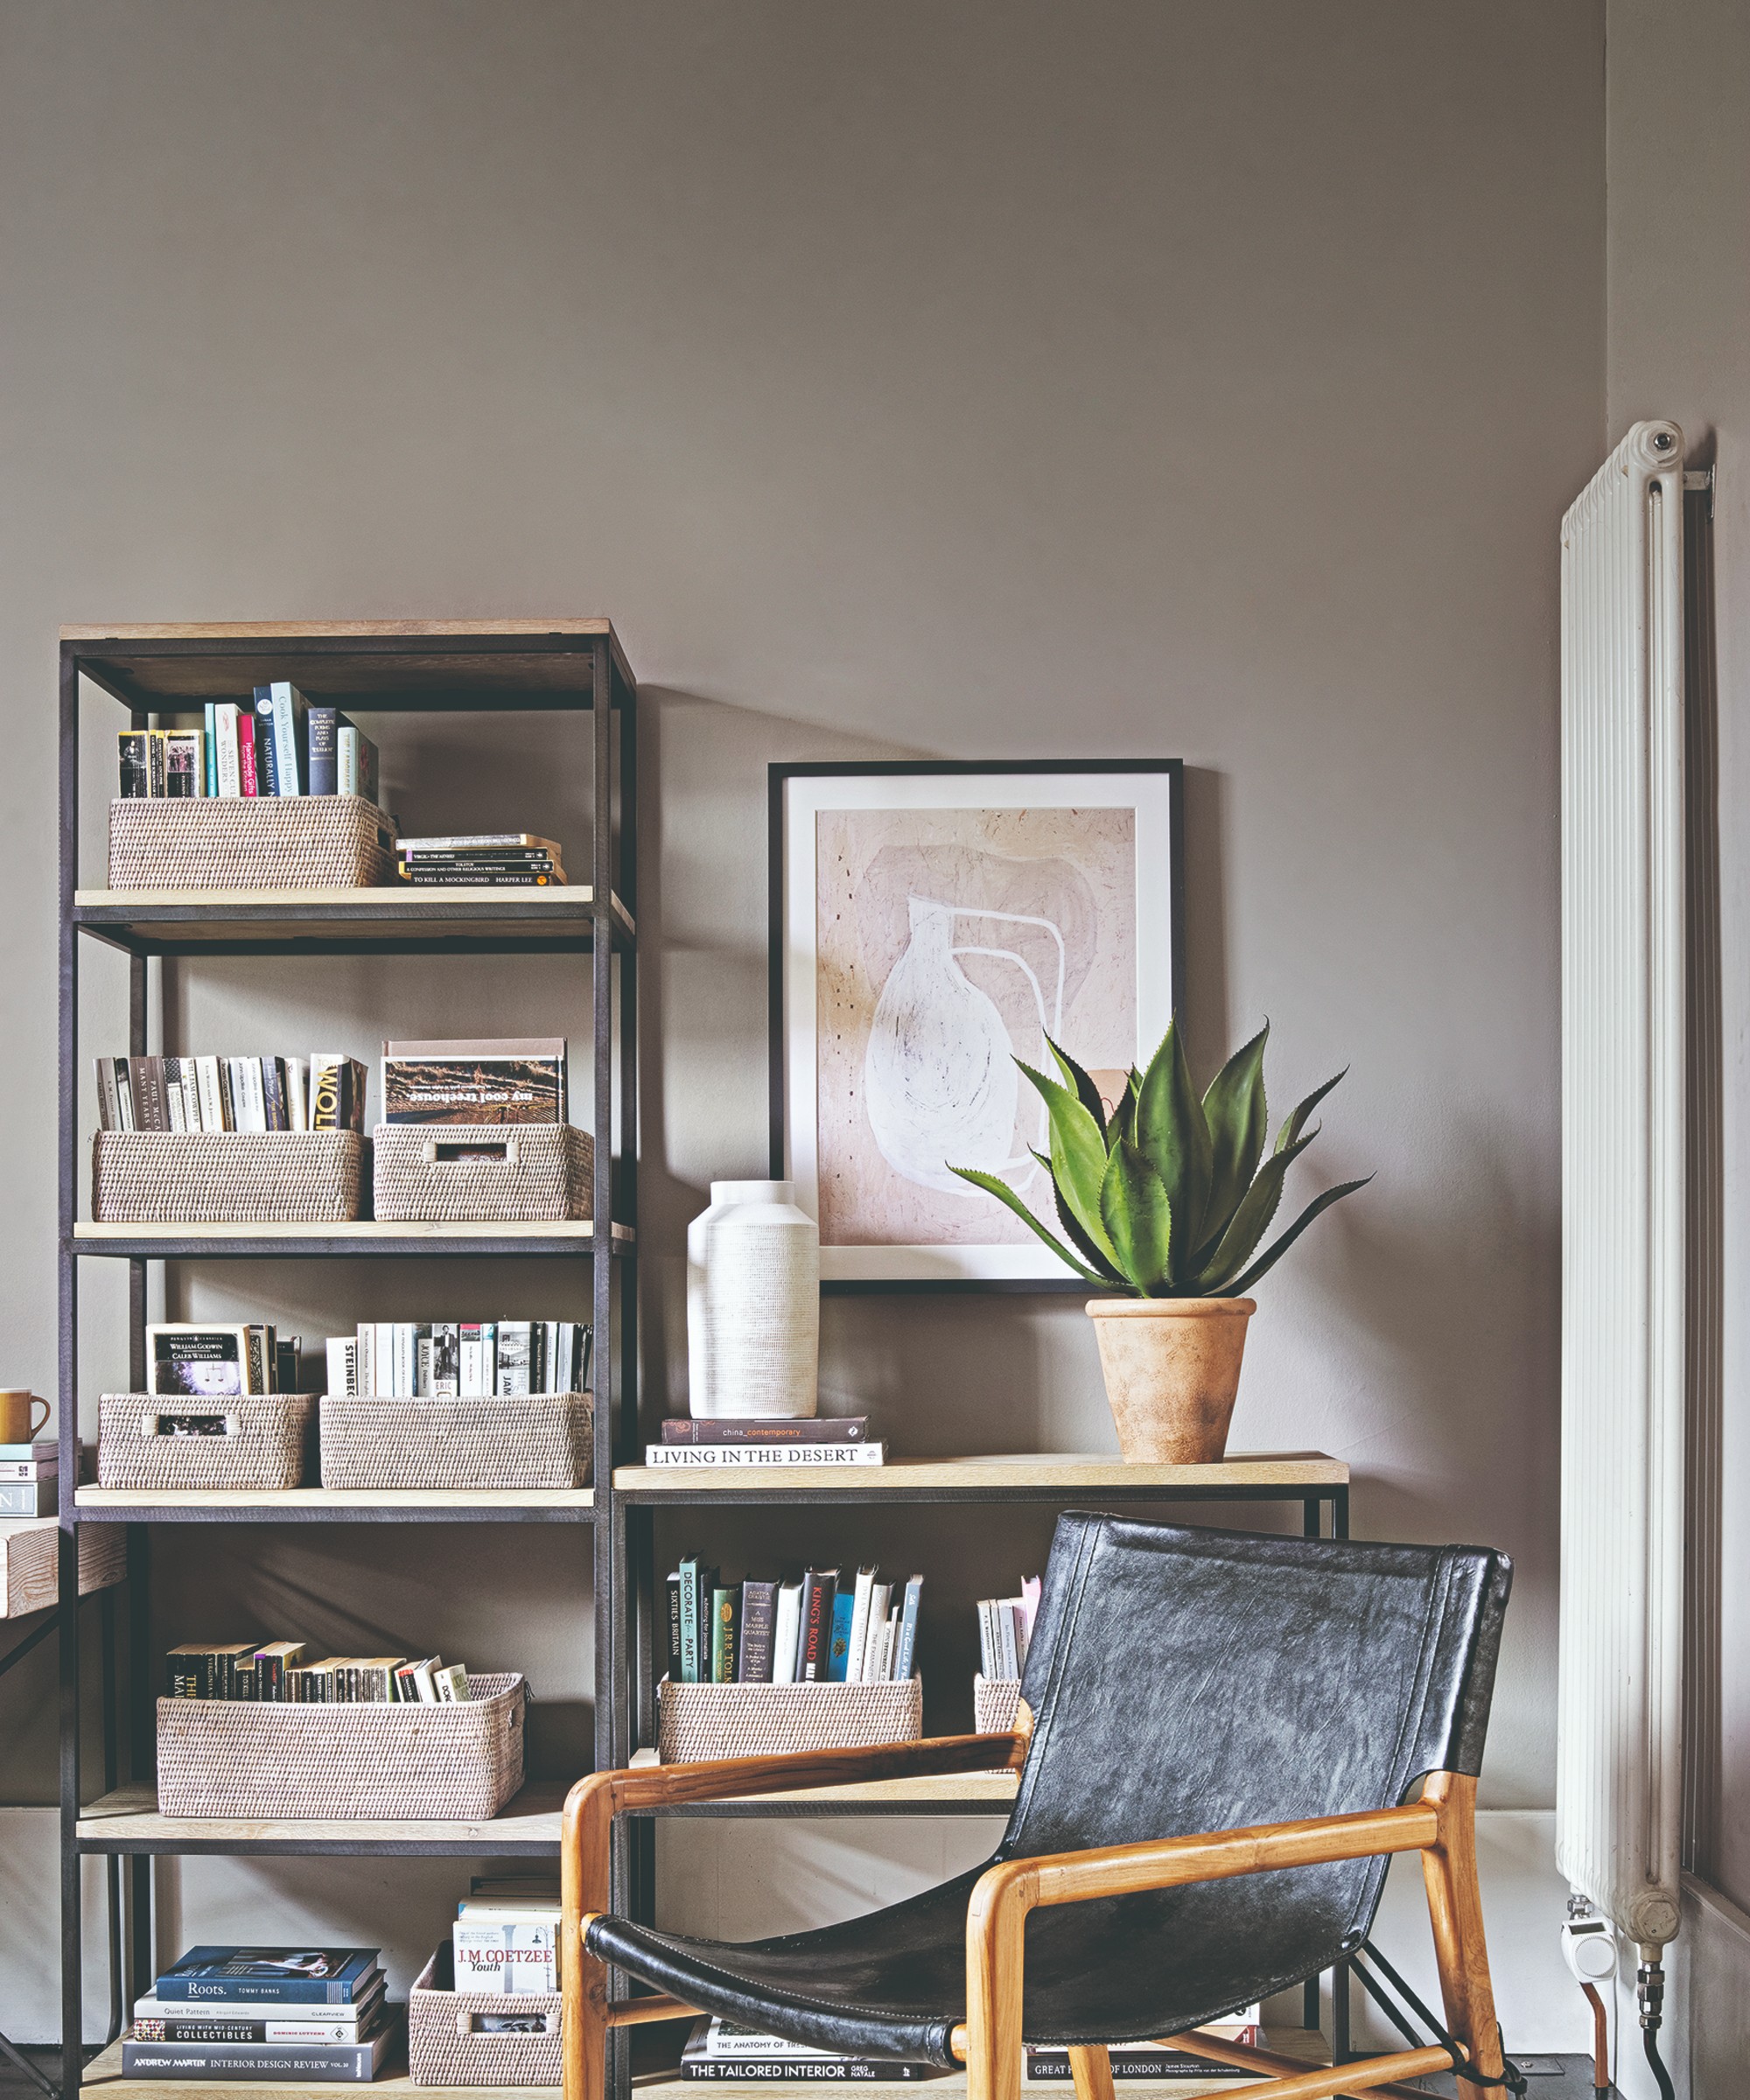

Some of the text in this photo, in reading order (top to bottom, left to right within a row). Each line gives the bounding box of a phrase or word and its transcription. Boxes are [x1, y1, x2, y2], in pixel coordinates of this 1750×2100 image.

[278, 696, 294, 794] Cook Yourself Happy
[220, 739, 229, 783] WONDERS
[245, 742, 257, 794] Handmade Gifts
[263, 738, 276, 789] NATURALLY
[187, 1059, 196, 1092] WILLIAM
[139, 1067, 151, 1124] MANY YEARS
[150, 1081, 158, 1102] PAUL
[479, 1092, 508, 1102] cool
[512, 1091, 533, 1102] my
[191, 1093, 200, 1124] COWPER
[421, 1344, 430, 1368] JOYCE
[652, 1448, 858, 1464] LIVING IN THE DESERT
[684, 1572, 693, 1624] DECORATE
[809, 1586, 822, 1625] KING'S
[670, 1590, 680, 1656] SIXTIES BRITAIN
[857, 1618, 865, 1652] THOMAS
[685, 1638, 694, 1669] PARTY
[807, 1628, 818, 1660] ROAD
[881, 1642, 891, 1673] STEINBECK
[903, 1636, 912, 1652] Good
[867, 1646, 878, 1677] EXAMINED
[471, 1961, 500, 1971] Youth
[485, 1950, 553, 1963] COETZEE
[187, 1981, 228, 1995] Roots.
[164, 2007, 184, 2016] Quiet
[186, 2007, 211, 2016] Pattern
[176, 2030, 253, 2040] COLLECTIBLES
[133, 2058, 172, 2067] ANDREW
[173, 2058, 206, 2067] MARTIN
[210, 2059, 256, 2068] INTERIOR
[256, 2060, 291, 2068] DESIGN
[293, 2060, 328, 2069] REVIEW
[690, 2065, 846, 2077] THE TAILORED INTERIOR
[1034, 2064, 1162, 2074] GREAT LONDON
